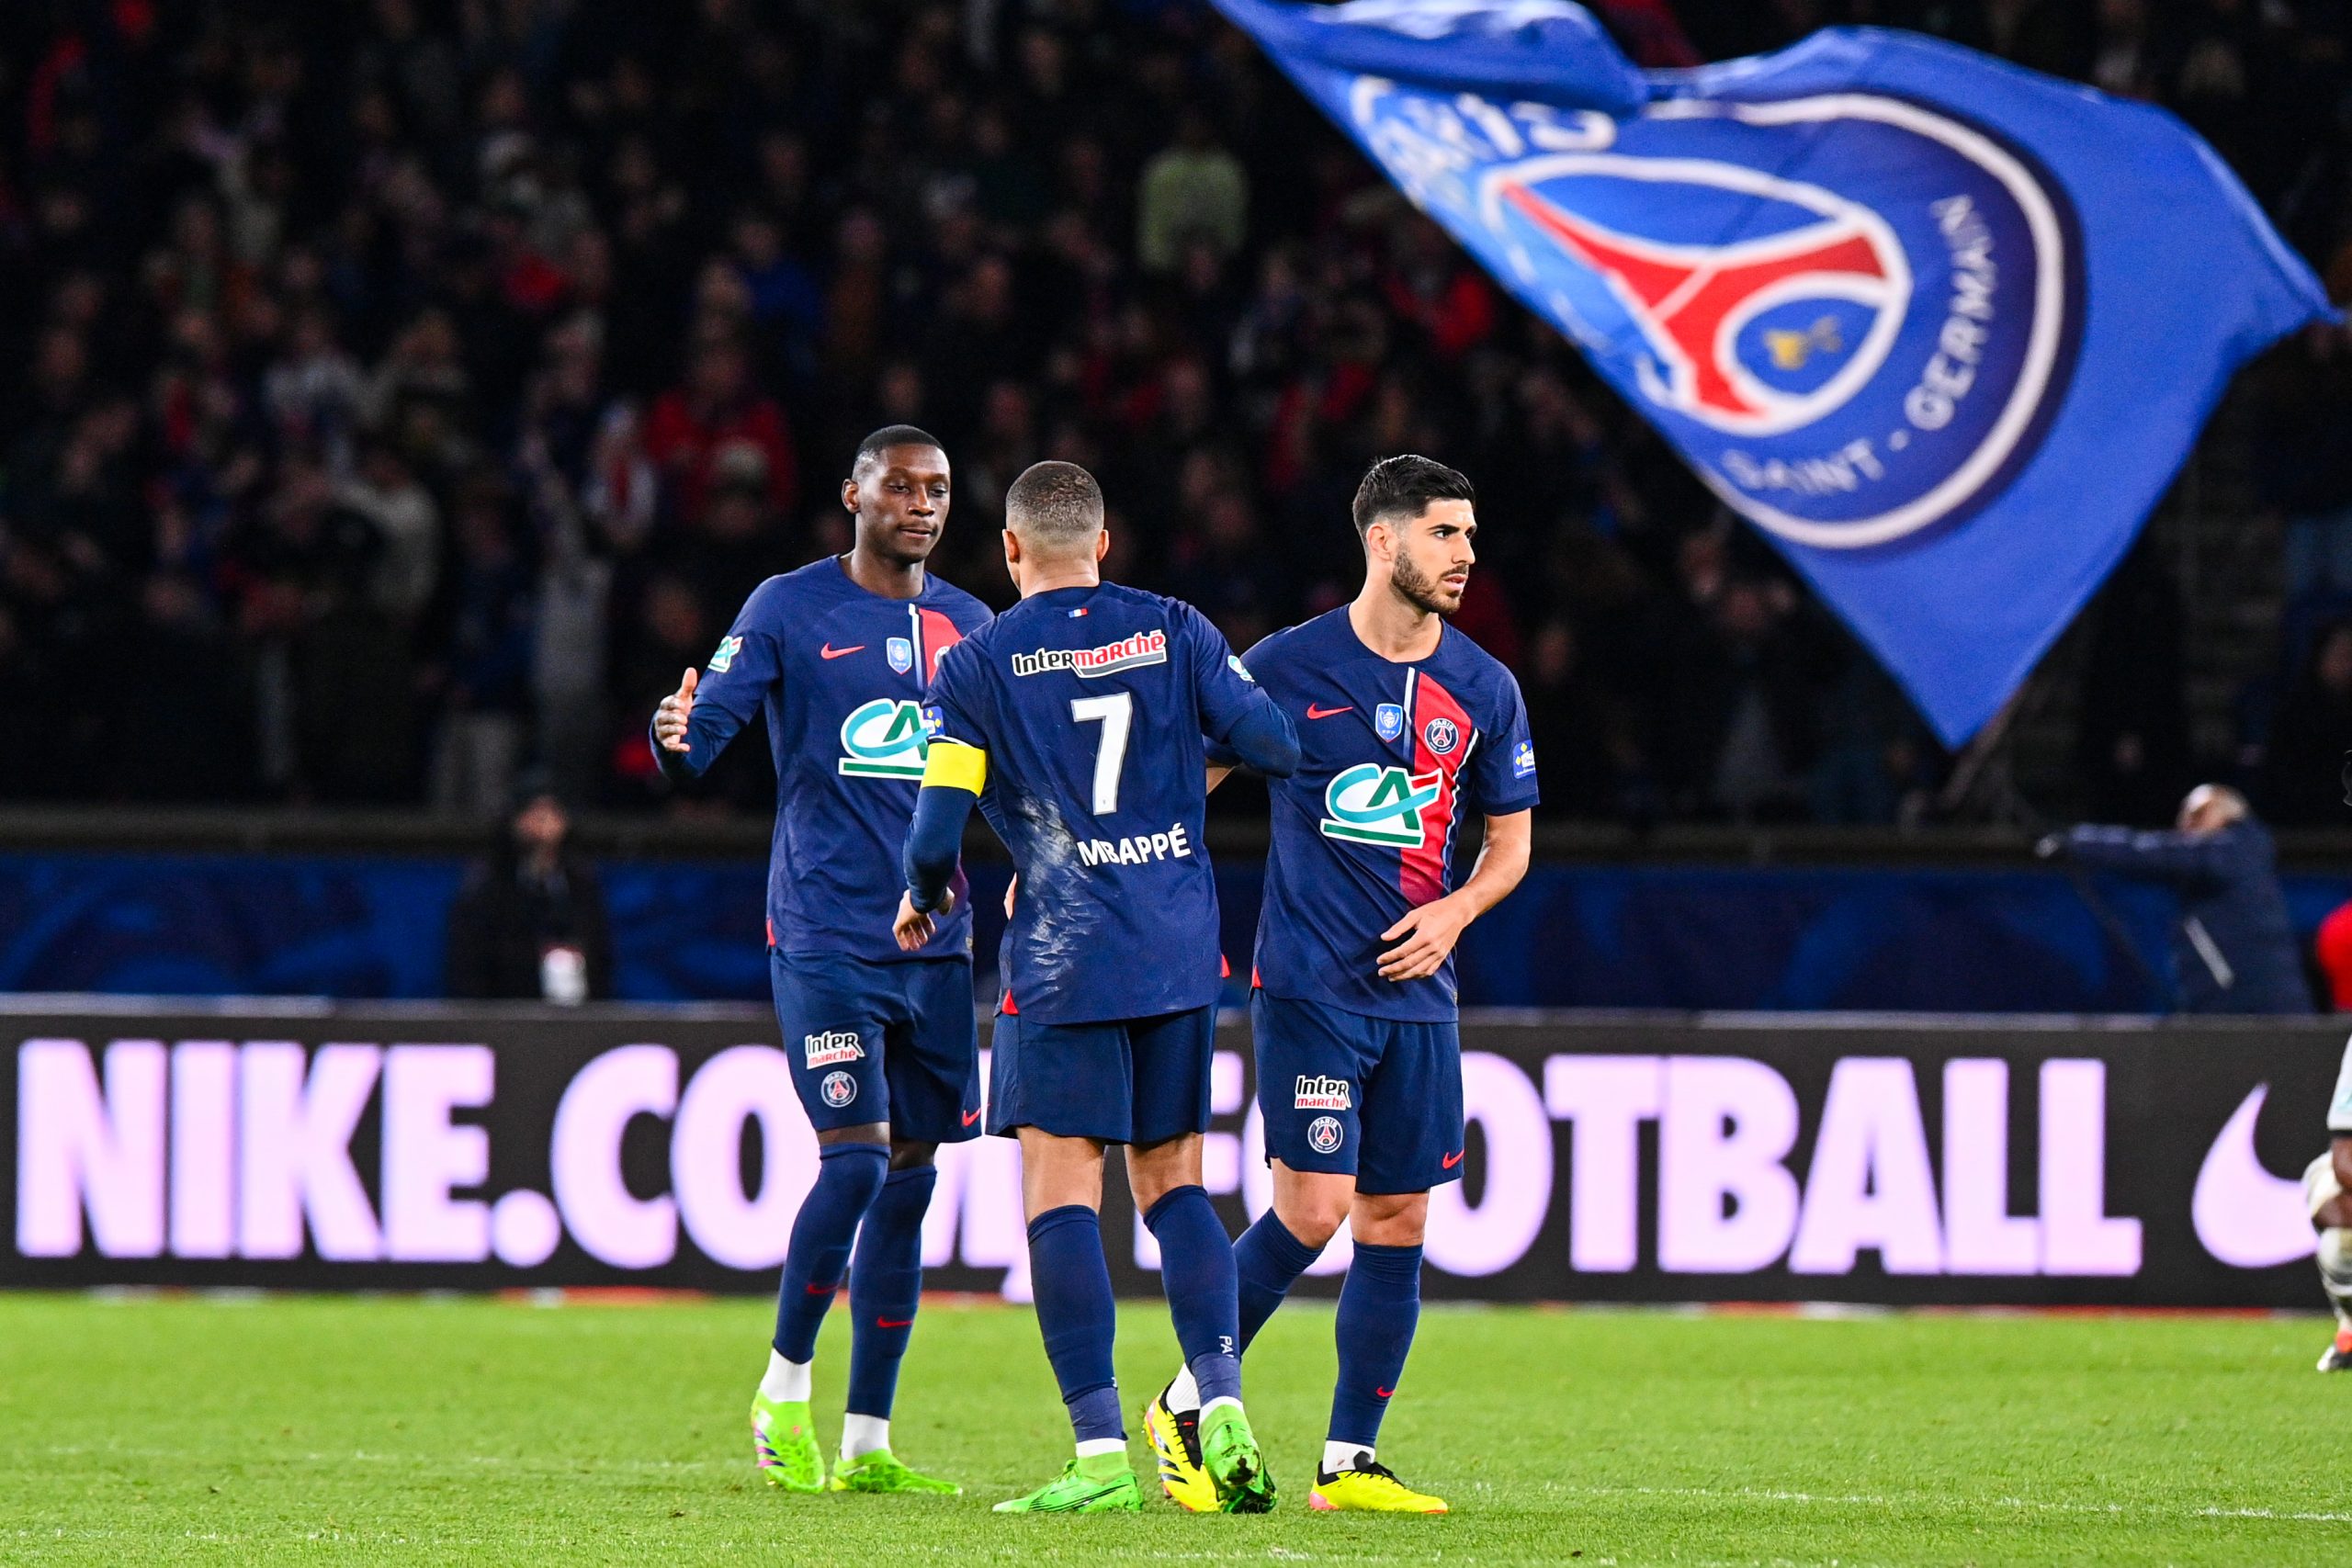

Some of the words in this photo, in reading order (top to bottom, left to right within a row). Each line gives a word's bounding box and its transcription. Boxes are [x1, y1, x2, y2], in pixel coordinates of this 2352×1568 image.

[1905, 193, 1997, 431] GERMAIN
[1431, 719, 1455, 731] PARIS
[1070, 692, 1133, 815] 7
[1077, 822, 1191, 866] MBAPPÉ
[1314, 1118, 1338, 1128] PARIS
